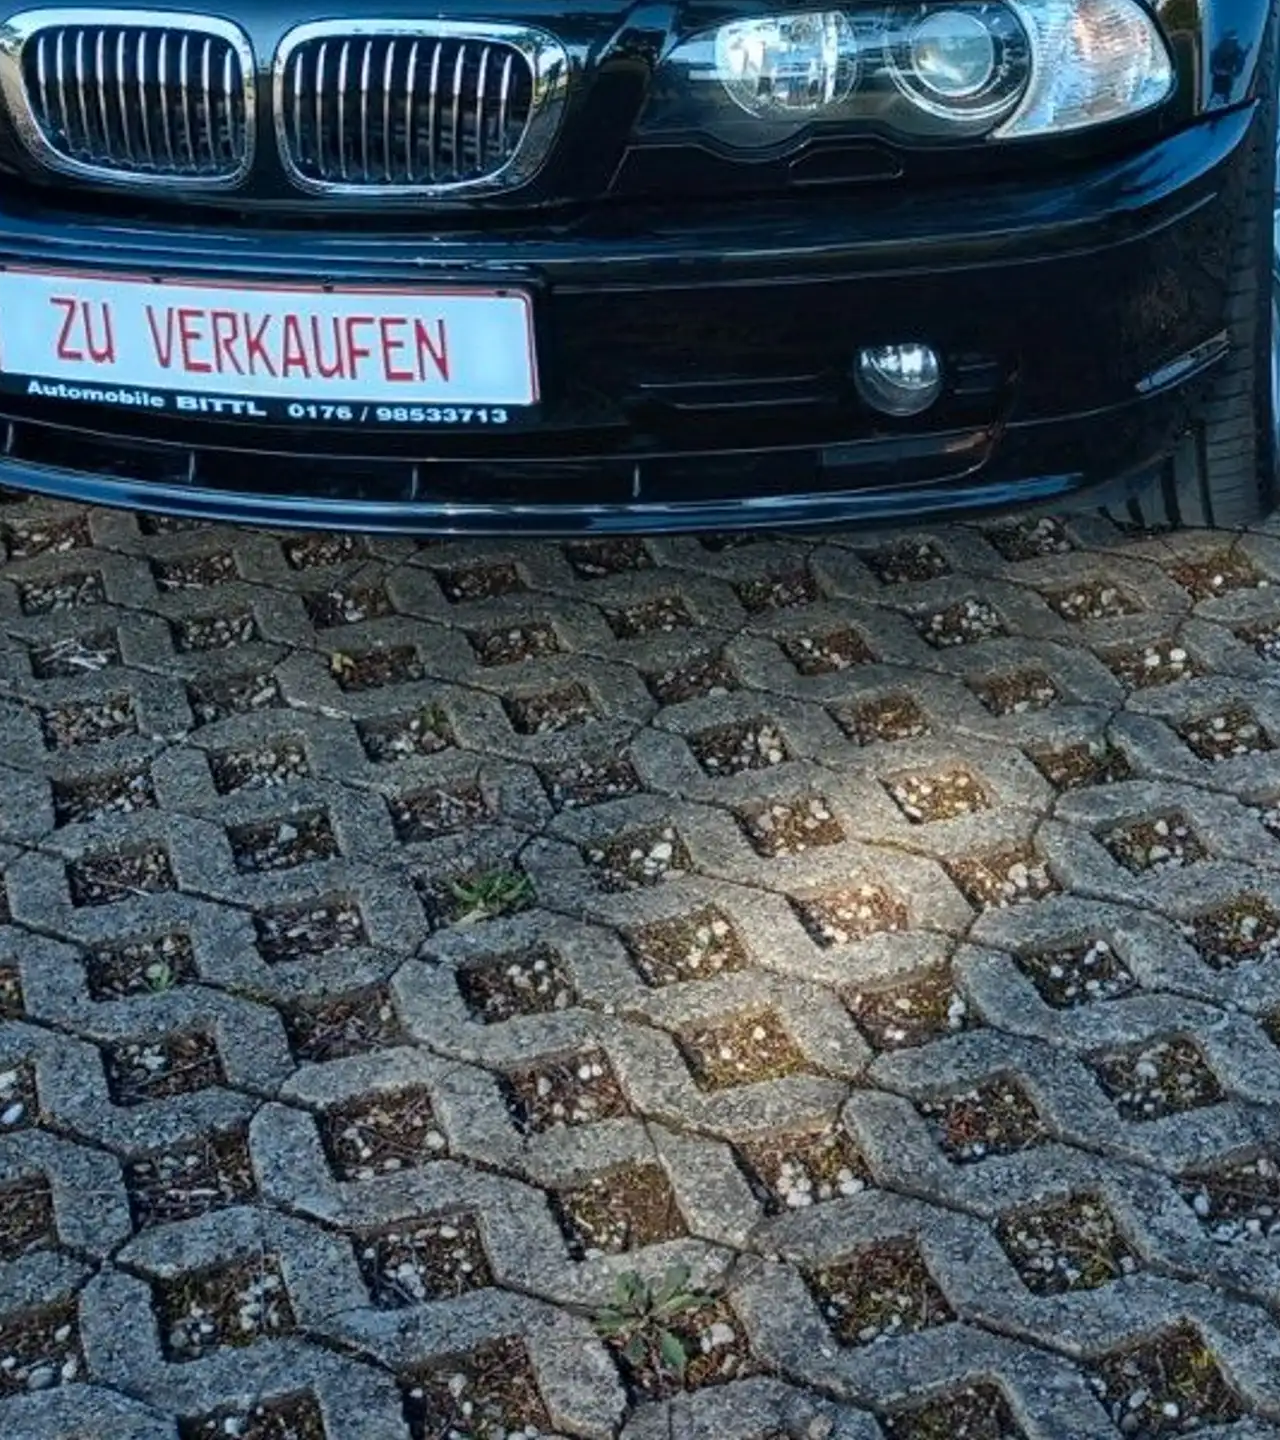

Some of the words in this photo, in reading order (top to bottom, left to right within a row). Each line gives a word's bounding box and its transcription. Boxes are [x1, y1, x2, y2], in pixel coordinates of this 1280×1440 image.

[50, 297, 116, 365] ZU
[146, 304, 450, 383] VERKAUFEN
[27, 380, 166, 408] Automobile
[176, 395, 268, 417] BITTL
[287, 402, 353, 420] 0176
[375, 408, 508, 424] 98533713
